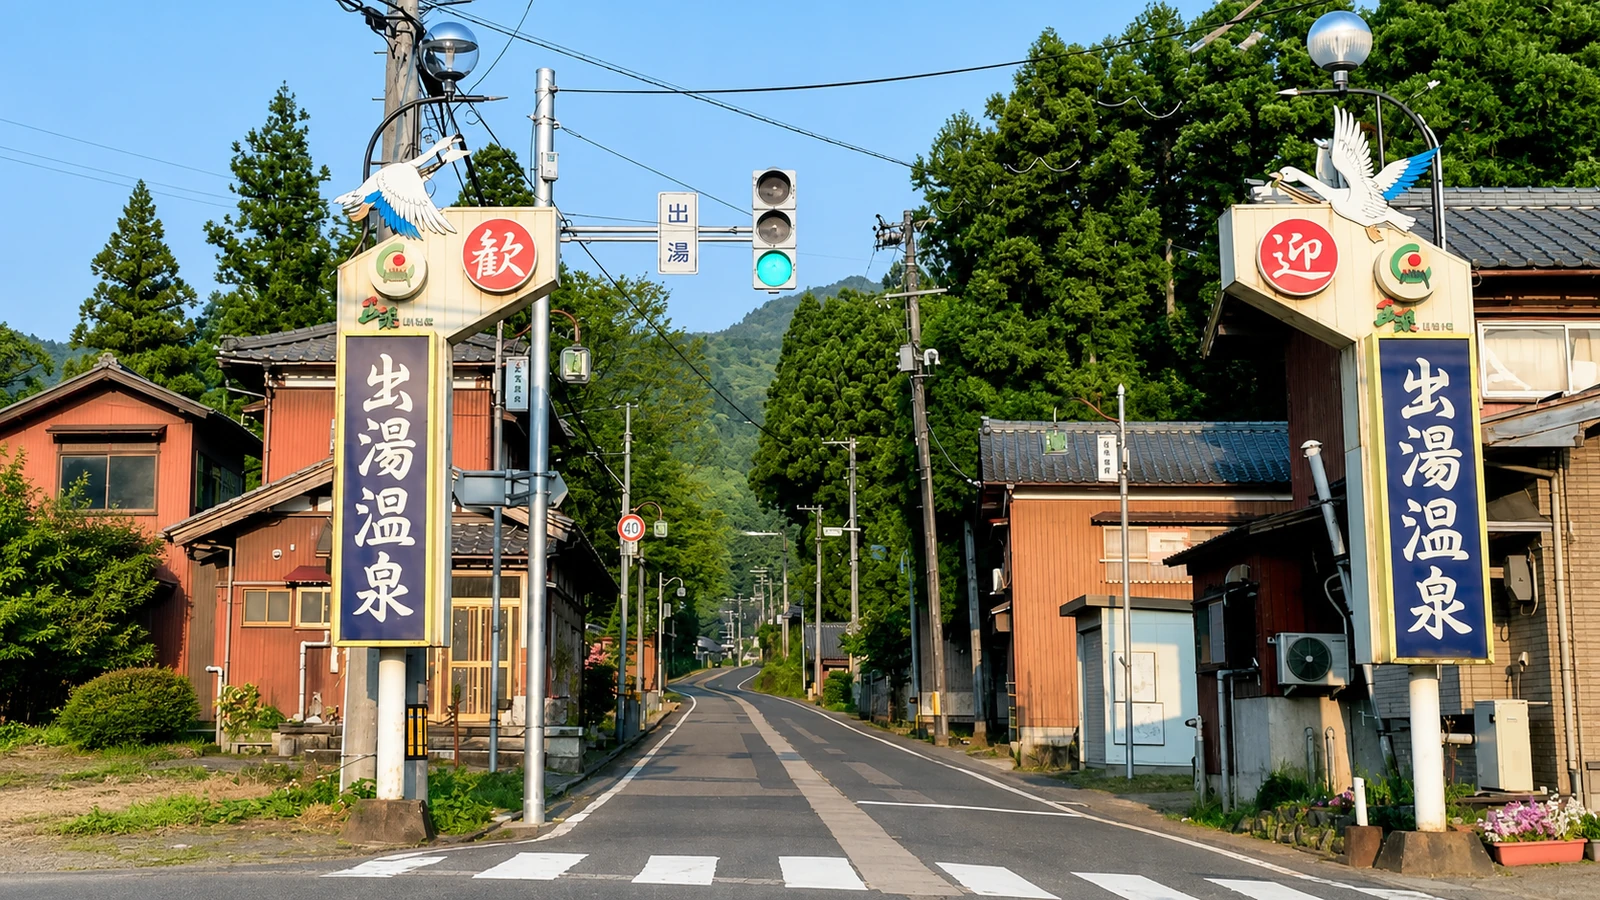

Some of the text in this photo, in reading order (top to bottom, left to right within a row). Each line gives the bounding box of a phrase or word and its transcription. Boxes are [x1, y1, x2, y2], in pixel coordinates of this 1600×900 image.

[470, 228, 526, 280] 歓
[667, 203, 690, 263] 出湯
[1272, 232, 1331, 280] 迎
[353, 353, 417, 623] 出湯温泉
[1398, 357, 1473, 641] 出湯温泉
[623, 522, 639, 535] 40
